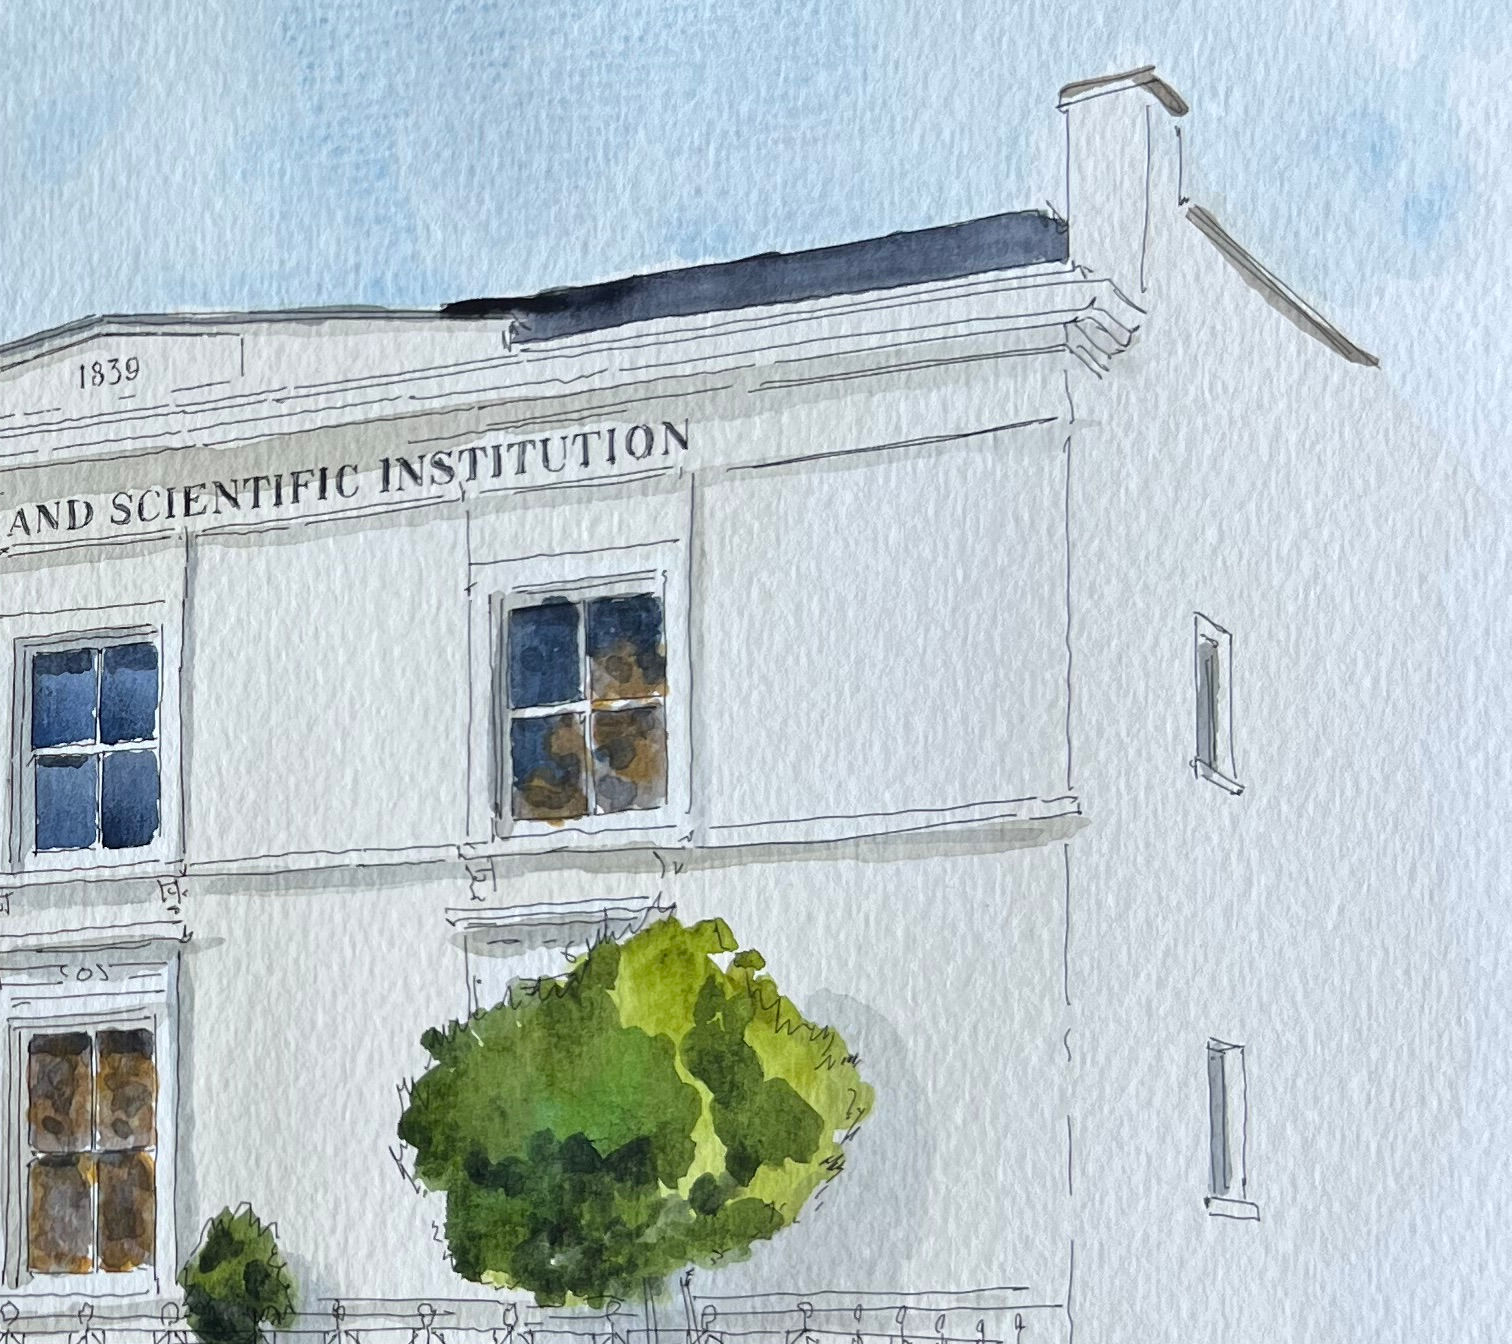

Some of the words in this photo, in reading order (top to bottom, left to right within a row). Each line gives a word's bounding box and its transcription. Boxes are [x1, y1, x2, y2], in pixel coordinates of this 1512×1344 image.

[80, 356, 140, 389] 1839
[7, 499, 95, 537] AND
[110, 464, 360, 525] SCIENTIFIC
[379, 418, 690, 493] INSTITUTION
